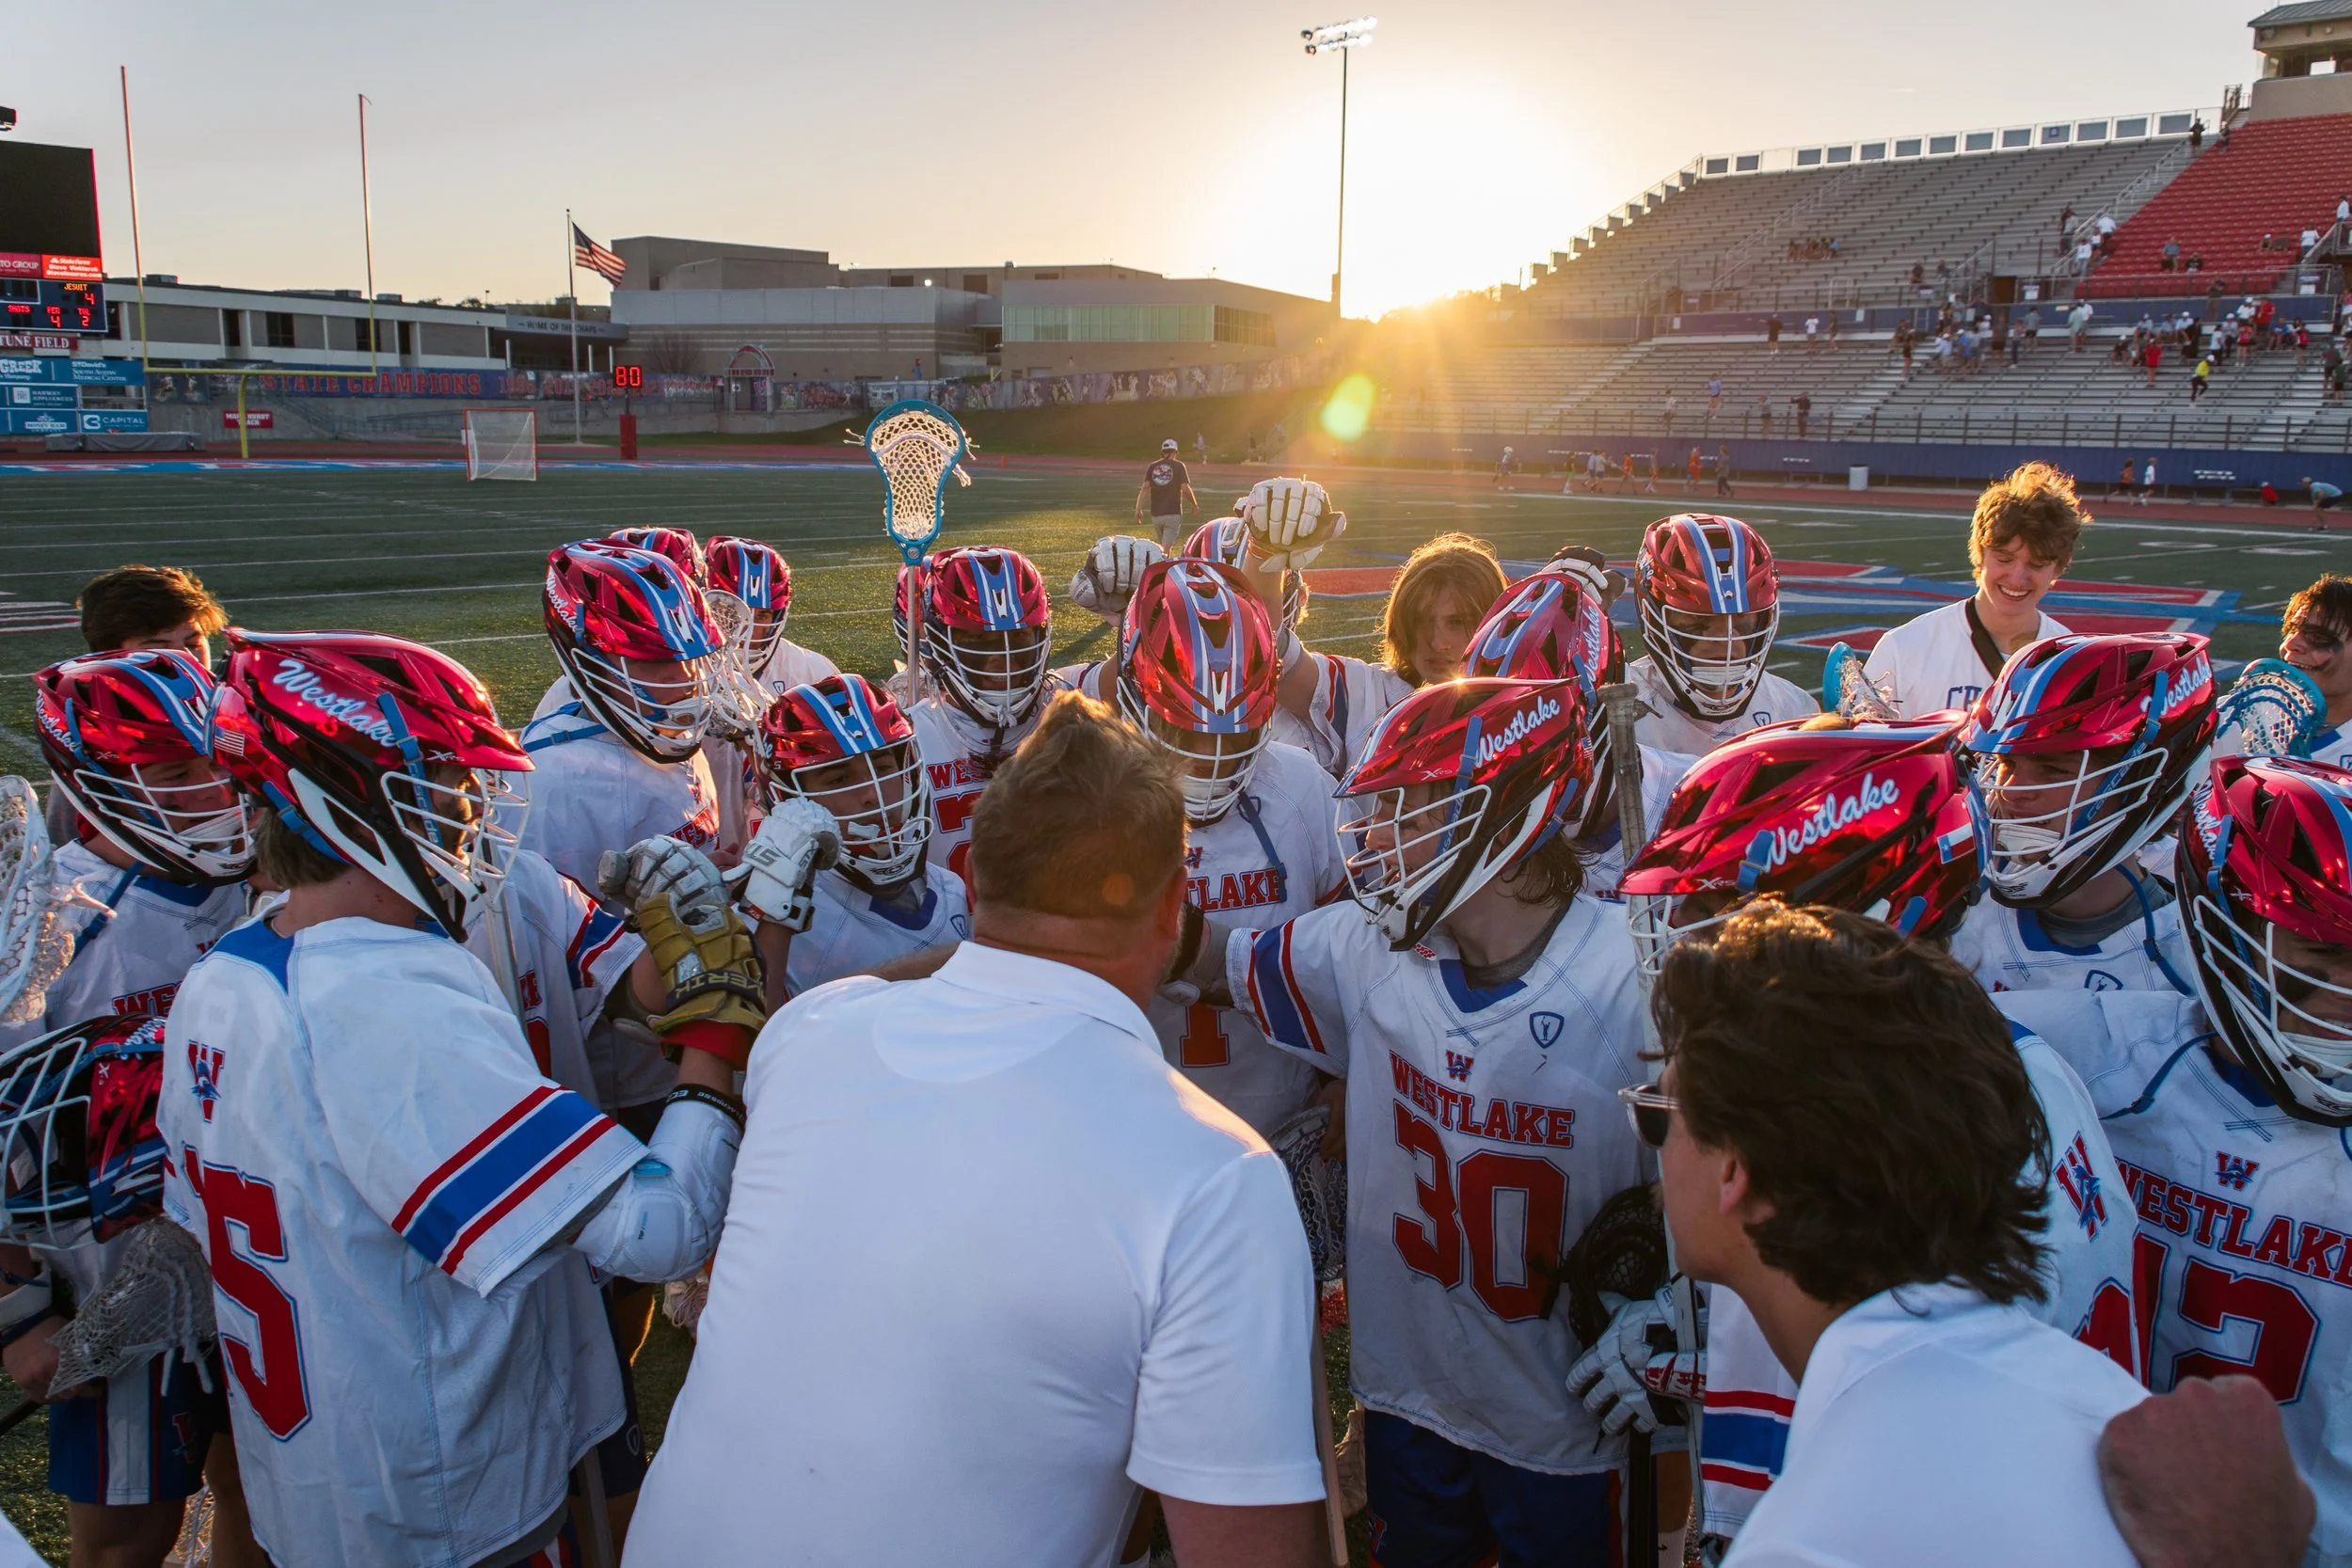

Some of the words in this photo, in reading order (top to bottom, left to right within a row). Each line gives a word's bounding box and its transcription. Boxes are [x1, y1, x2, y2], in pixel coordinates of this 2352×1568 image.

[11, 261, 39, 269] GROUP
[64, 283, 88, 292] JESUIT
[85, 293, 96, 306] 4
[50, 315, 61, 328] 4
[82, 316, 90, 327] 2
[34, 336, 70, 348] FIELD
[262, 375, 340, 392] STATE
[347, 372, 482, 395] CHAMPIONS
[616, 366, 641, 387] 80
[273, 658, 399, 748] Westlake
[1474, 695, 1560, 768] Westlake
[1745, 771, 1899, 873] Westlake
[747, 843, 781, 866] ST
[1445, 1049, 1474, 1083] W
[1389, 1049, 1576, 1148] WESTLAKE
[2214, 1150, 2260, 1191] W
[1392, 1098, 1569, 1323] 30
[184, 1141, 312, 1442] 5
